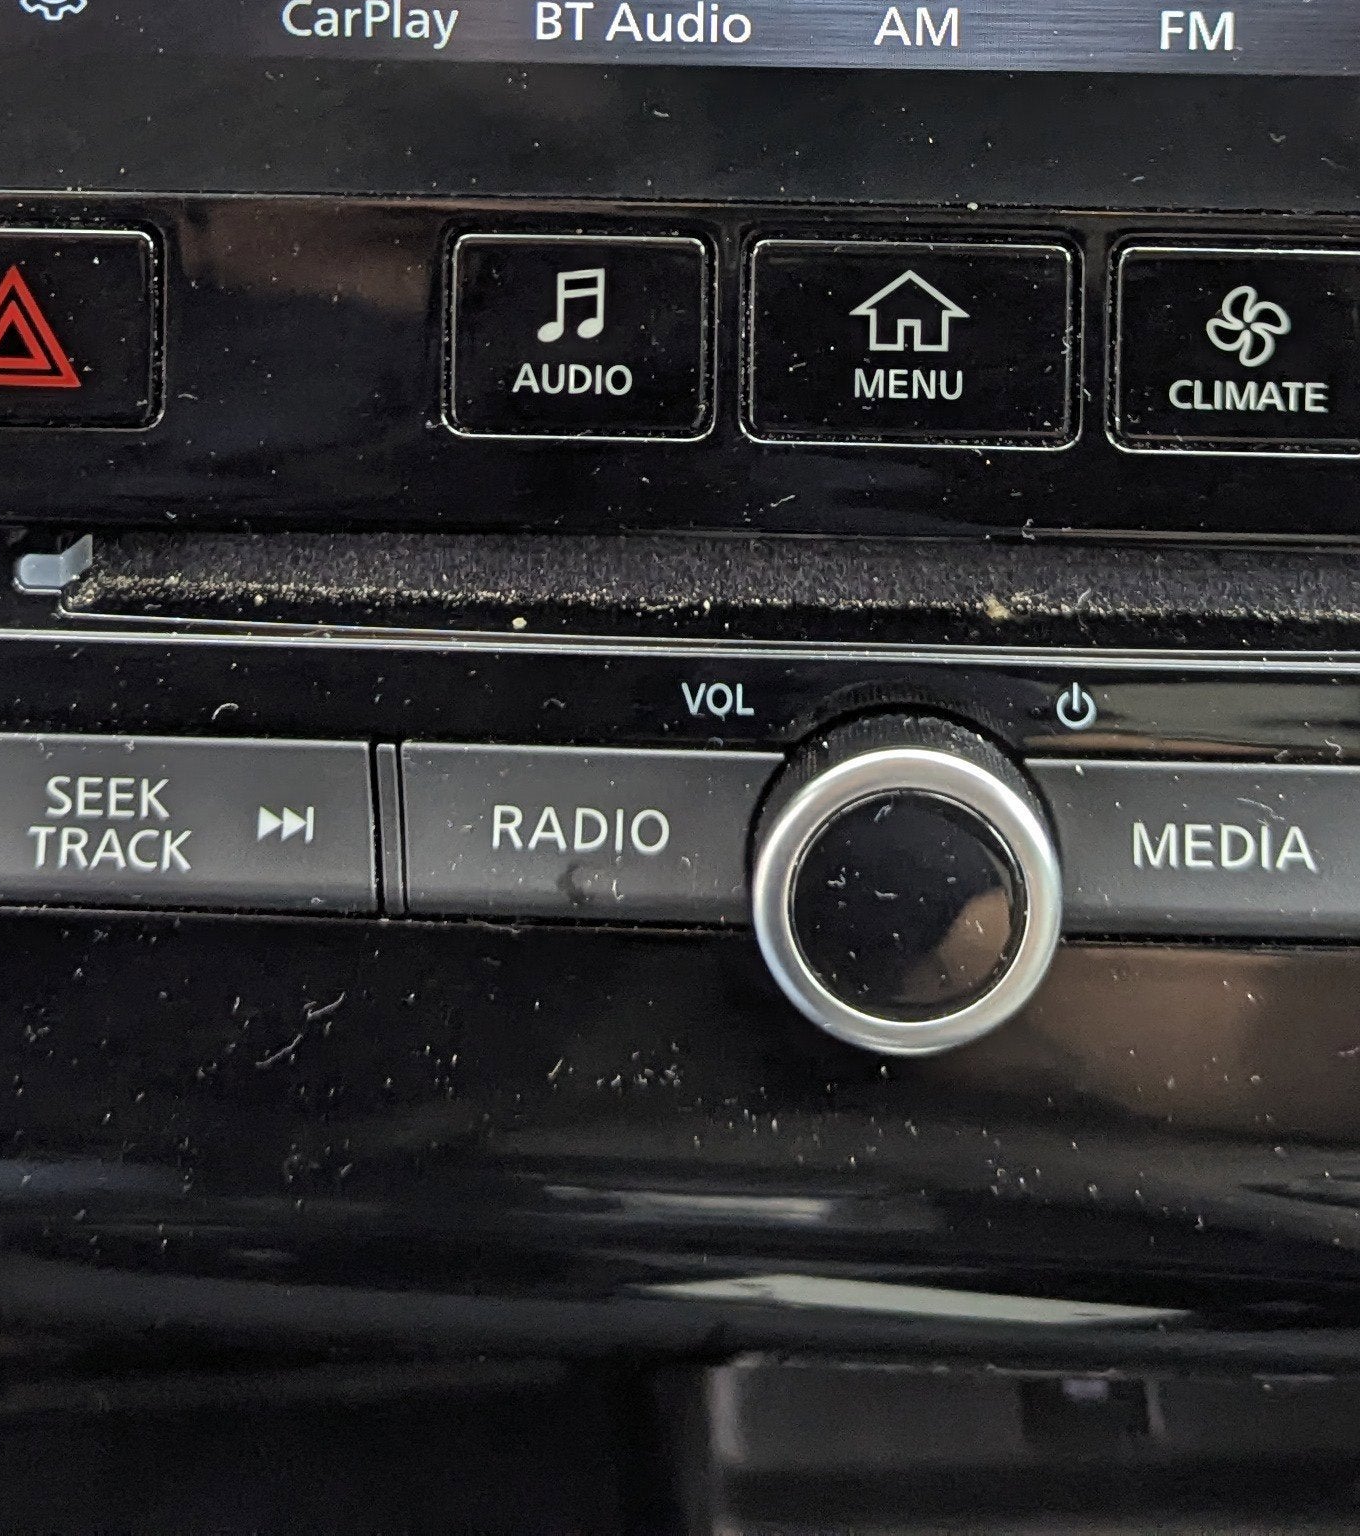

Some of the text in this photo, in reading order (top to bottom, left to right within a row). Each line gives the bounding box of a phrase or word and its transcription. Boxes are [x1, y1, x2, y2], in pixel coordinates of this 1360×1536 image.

[534, 1, 753, 44] BT Audio
[873, 6, 961, 47] AM
[1159, 10, 1237, 52] FM
[511, 362, 634, 397] AUDIO
[853, 367, 965, 402] MENU
[1167, 378, 1331, 416] CLIMATE
[680, 681, 755, 719] VOL
[44, 774, 172, 820] SEEK
[27, 825, 192, 874] TRACK
[491, 804, 671, 857] RADIO
[1131, 821, 1320, 873] MEDIA
